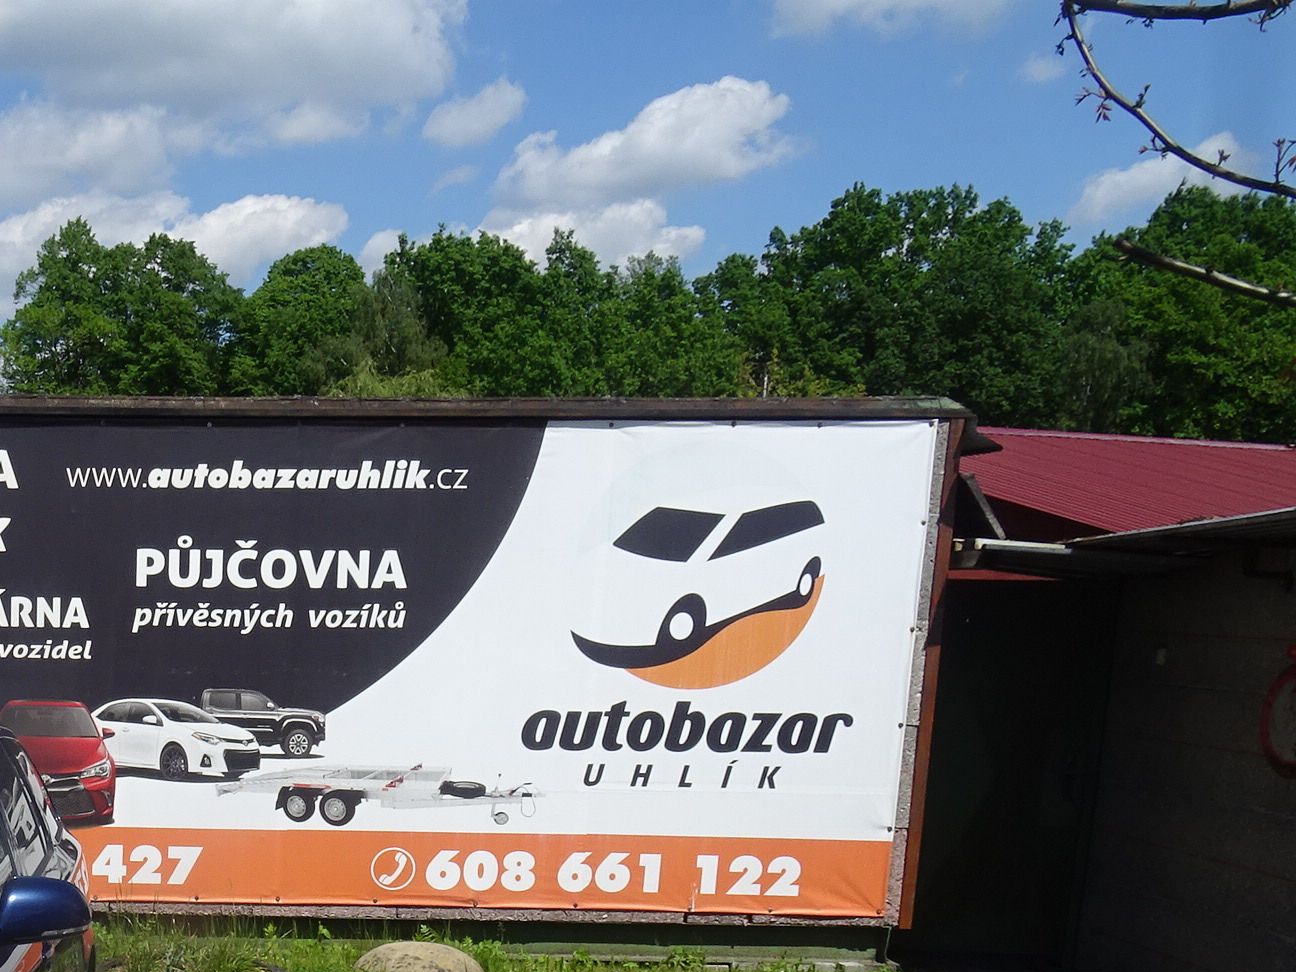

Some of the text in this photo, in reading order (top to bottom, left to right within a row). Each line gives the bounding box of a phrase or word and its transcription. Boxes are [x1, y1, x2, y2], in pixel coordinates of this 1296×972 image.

[66, 459, 469, 490] www.autobazaruhlik.cz
[135, 534, 408, 589] PŮJČOVNA
[131, 600, 407, 635] přívěsných vozíků
[521, 700, 854, 754] autobazar
[583, 759, 783, 789] UHLÍK
[91, 844, 204, 885] 427
[425, 849, 802, 897] 608 661 122
